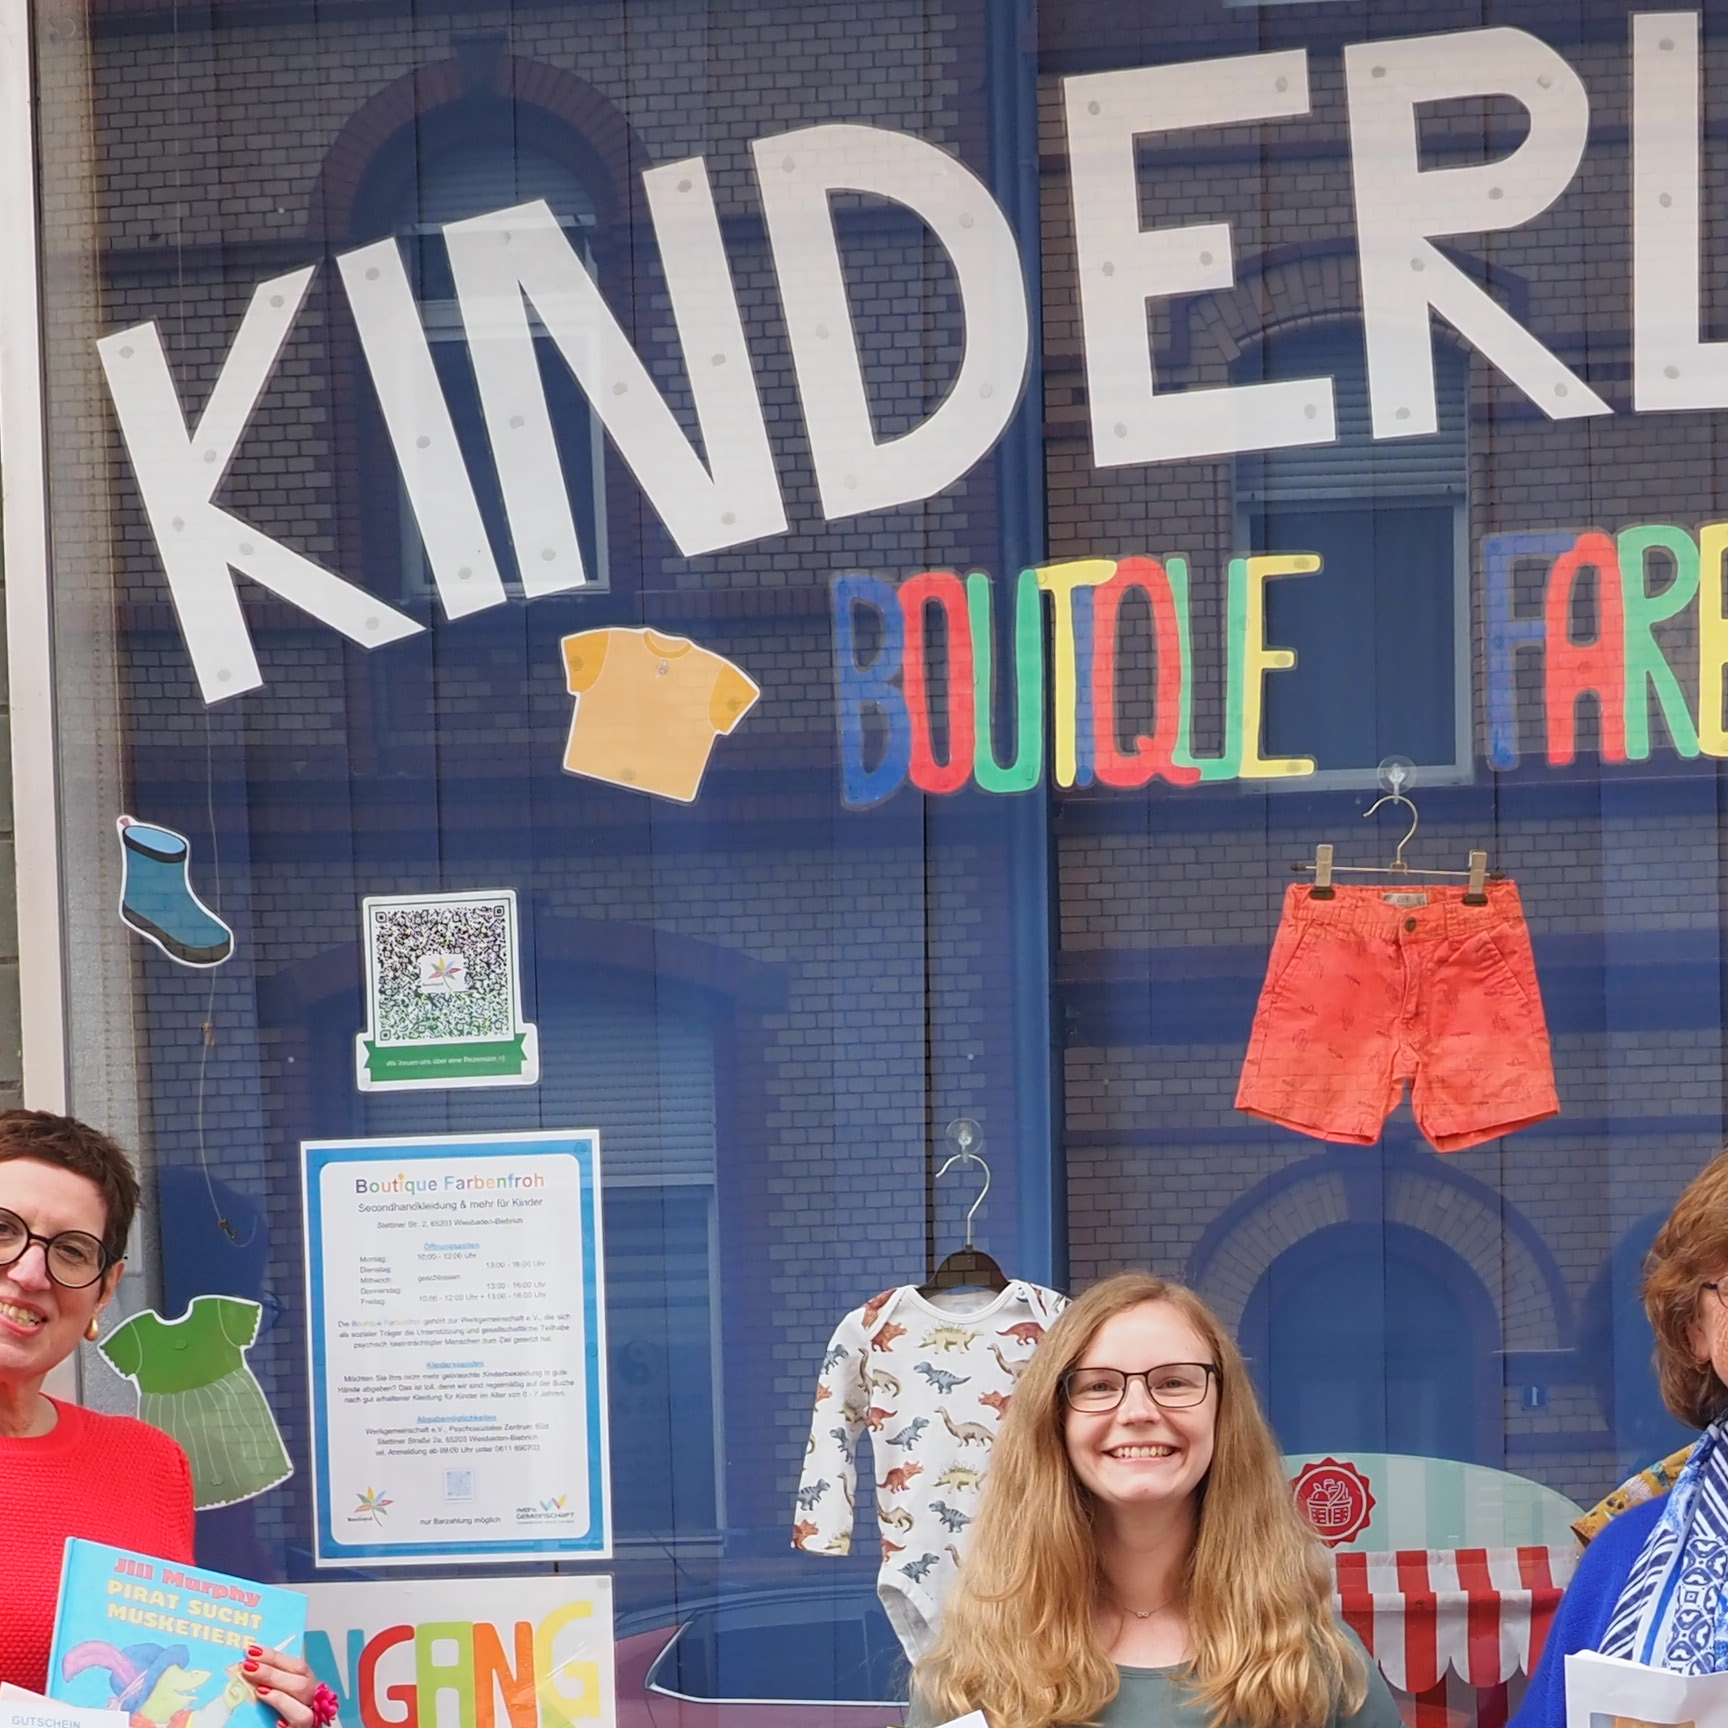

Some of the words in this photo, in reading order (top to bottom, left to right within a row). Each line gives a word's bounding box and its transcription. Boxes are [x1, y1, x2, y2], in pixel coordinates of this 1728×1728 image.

[356, 1173, 437, 1196] Boutique
[444, 1173, 544, 1191] Farbenfroh
[358, 1201, 457, 1213] Secondhandkleidung
[470, 1199, 493, 1209] mehr
[513, 1197, 543, 1207] Kinder
[107, 1579, 180, 1611] PIRAT
[188, 1598, 263, 1630] SUCHT
[114, 1557, 154, 1581] Jill
[161, 1568, 262, 1608] Murphy
[107, 1603, 257, 1650] MUSKETIERE
